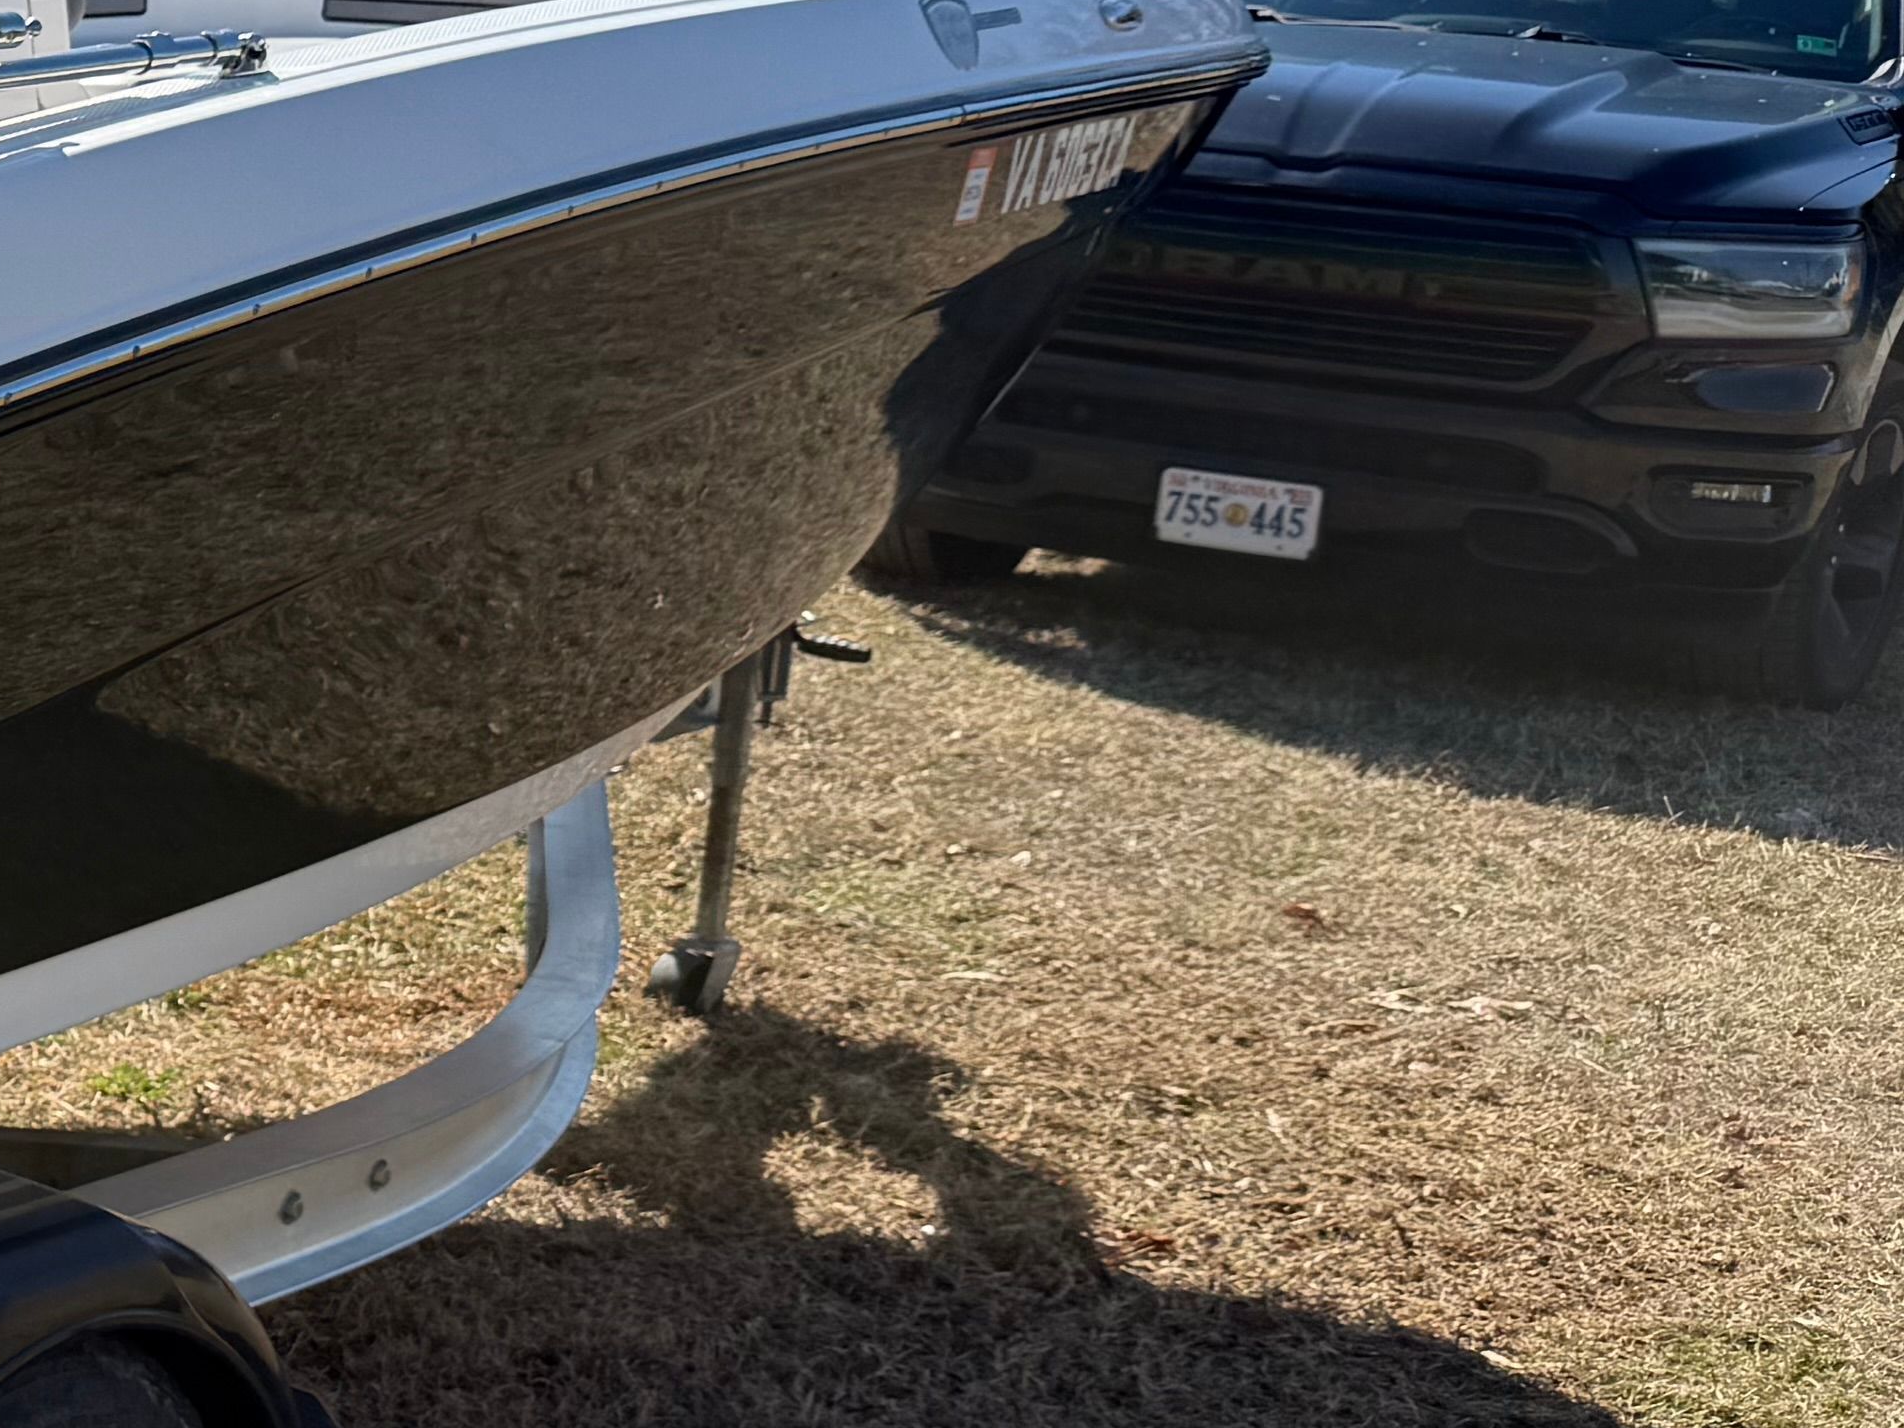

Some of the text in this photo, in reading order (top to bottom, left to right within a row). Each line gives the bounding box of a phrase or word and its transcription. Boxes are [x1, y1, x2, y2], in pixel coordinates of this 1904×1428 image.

[1000, 133, 1047, 215] VA
[1164, 491, 1308, 539] 755 445
